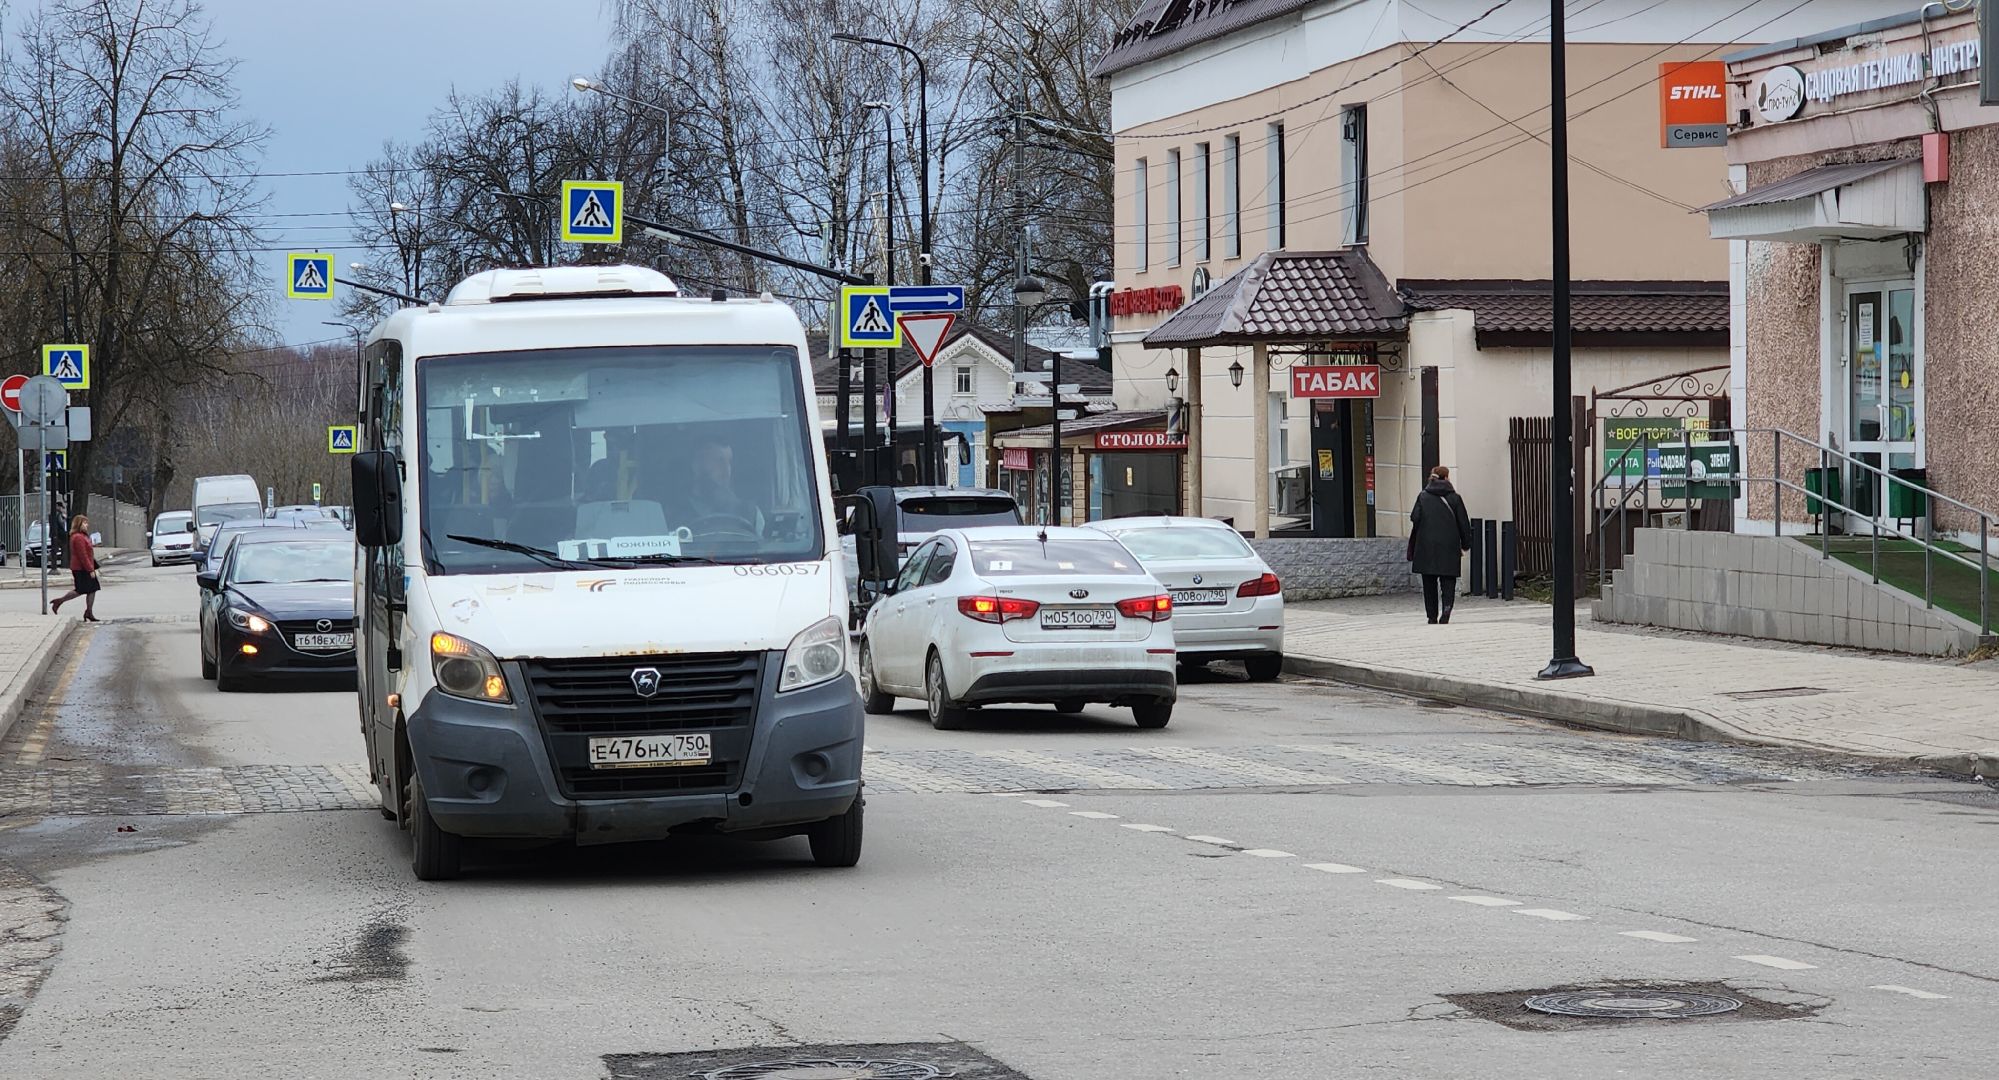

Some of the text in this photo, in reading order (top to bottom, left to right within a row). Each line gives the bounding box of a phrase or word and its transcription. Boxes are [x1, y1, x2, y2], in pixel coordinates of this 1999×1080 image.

[1805, 64, 1859, 102] САДОВАЯ
[1863, 52, 1918, 88] ТЕХНИКА
[1670, 85, 1722, 100] STIHL
[1673, 128, 1719, 142] Сервис
[1296, 372, 1376, 391] ТАБАК
[1710, 453, 1730, 468] ЭЛЕКТР
[616, 540, 671, 548] ЮЖНЫЙ
[733, 564, 821, 577] 066057
[1071, 589, 1087, 598] KIA
[596, 736, 705, 760] Е476НХ 750
